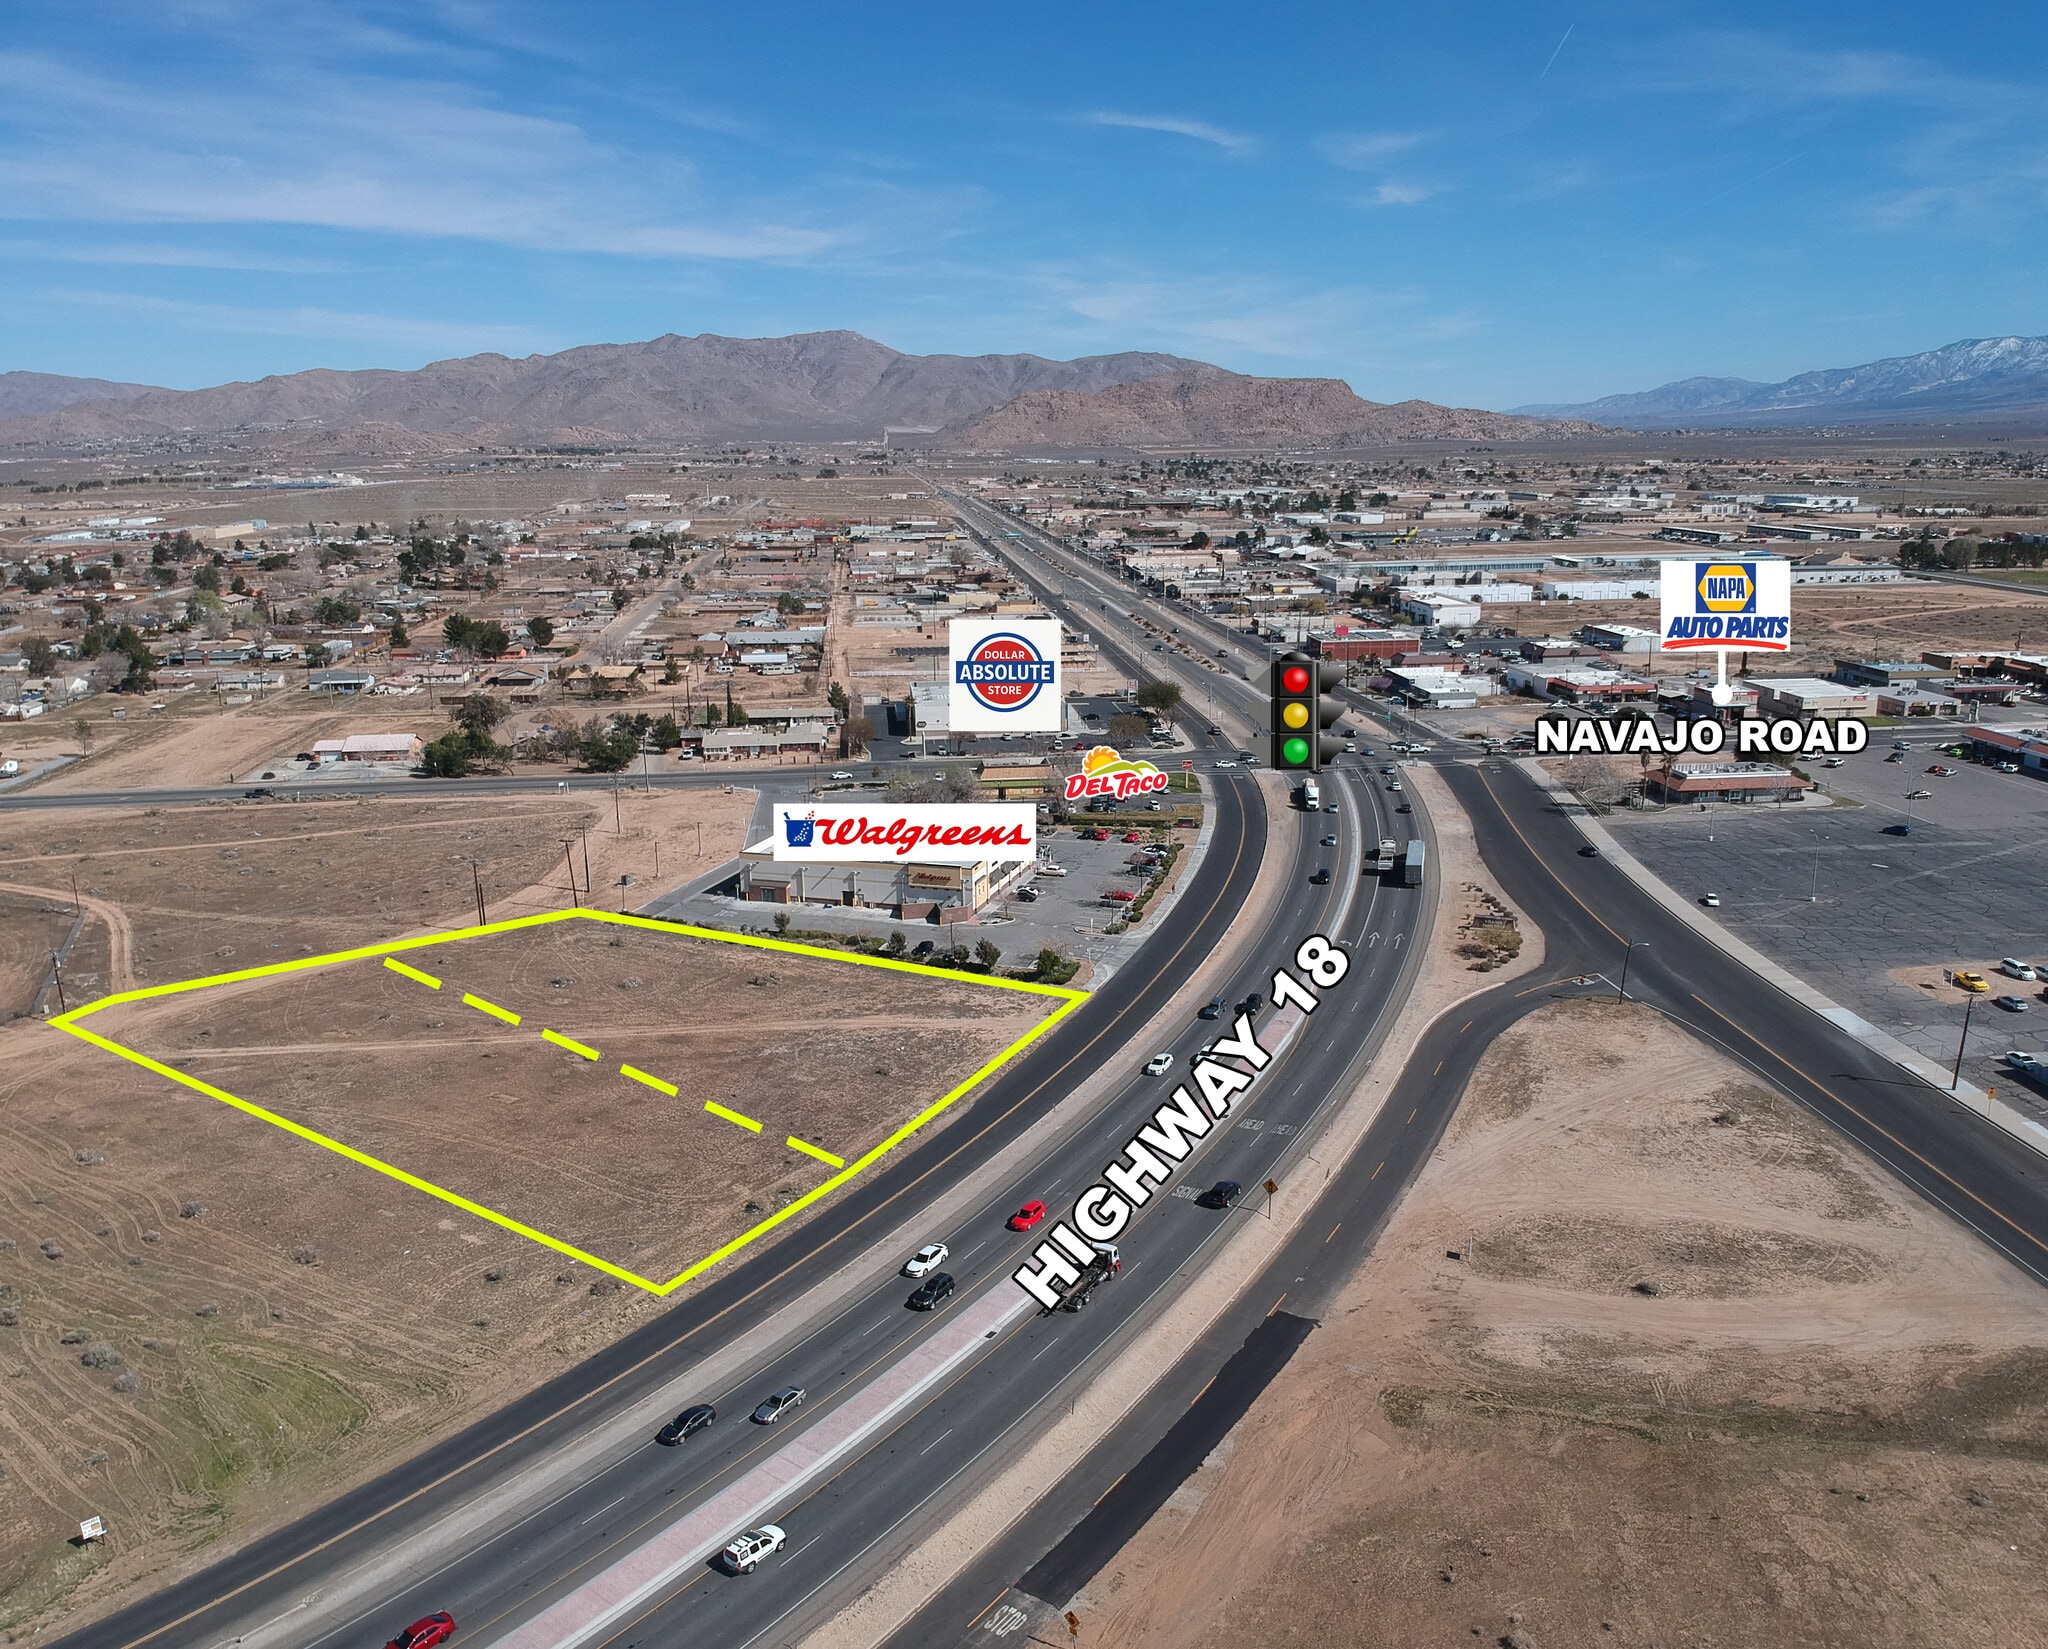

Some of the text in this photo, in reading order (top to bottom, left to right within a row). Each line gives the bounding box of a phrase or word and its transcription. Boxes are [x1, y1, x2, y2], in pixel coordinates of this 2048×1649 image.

[917, 872, 952, 882] Walgreens
[1237, 1118, 1265, 1131] AHEAD
[984, 1604, 1028, 1638] STOP
